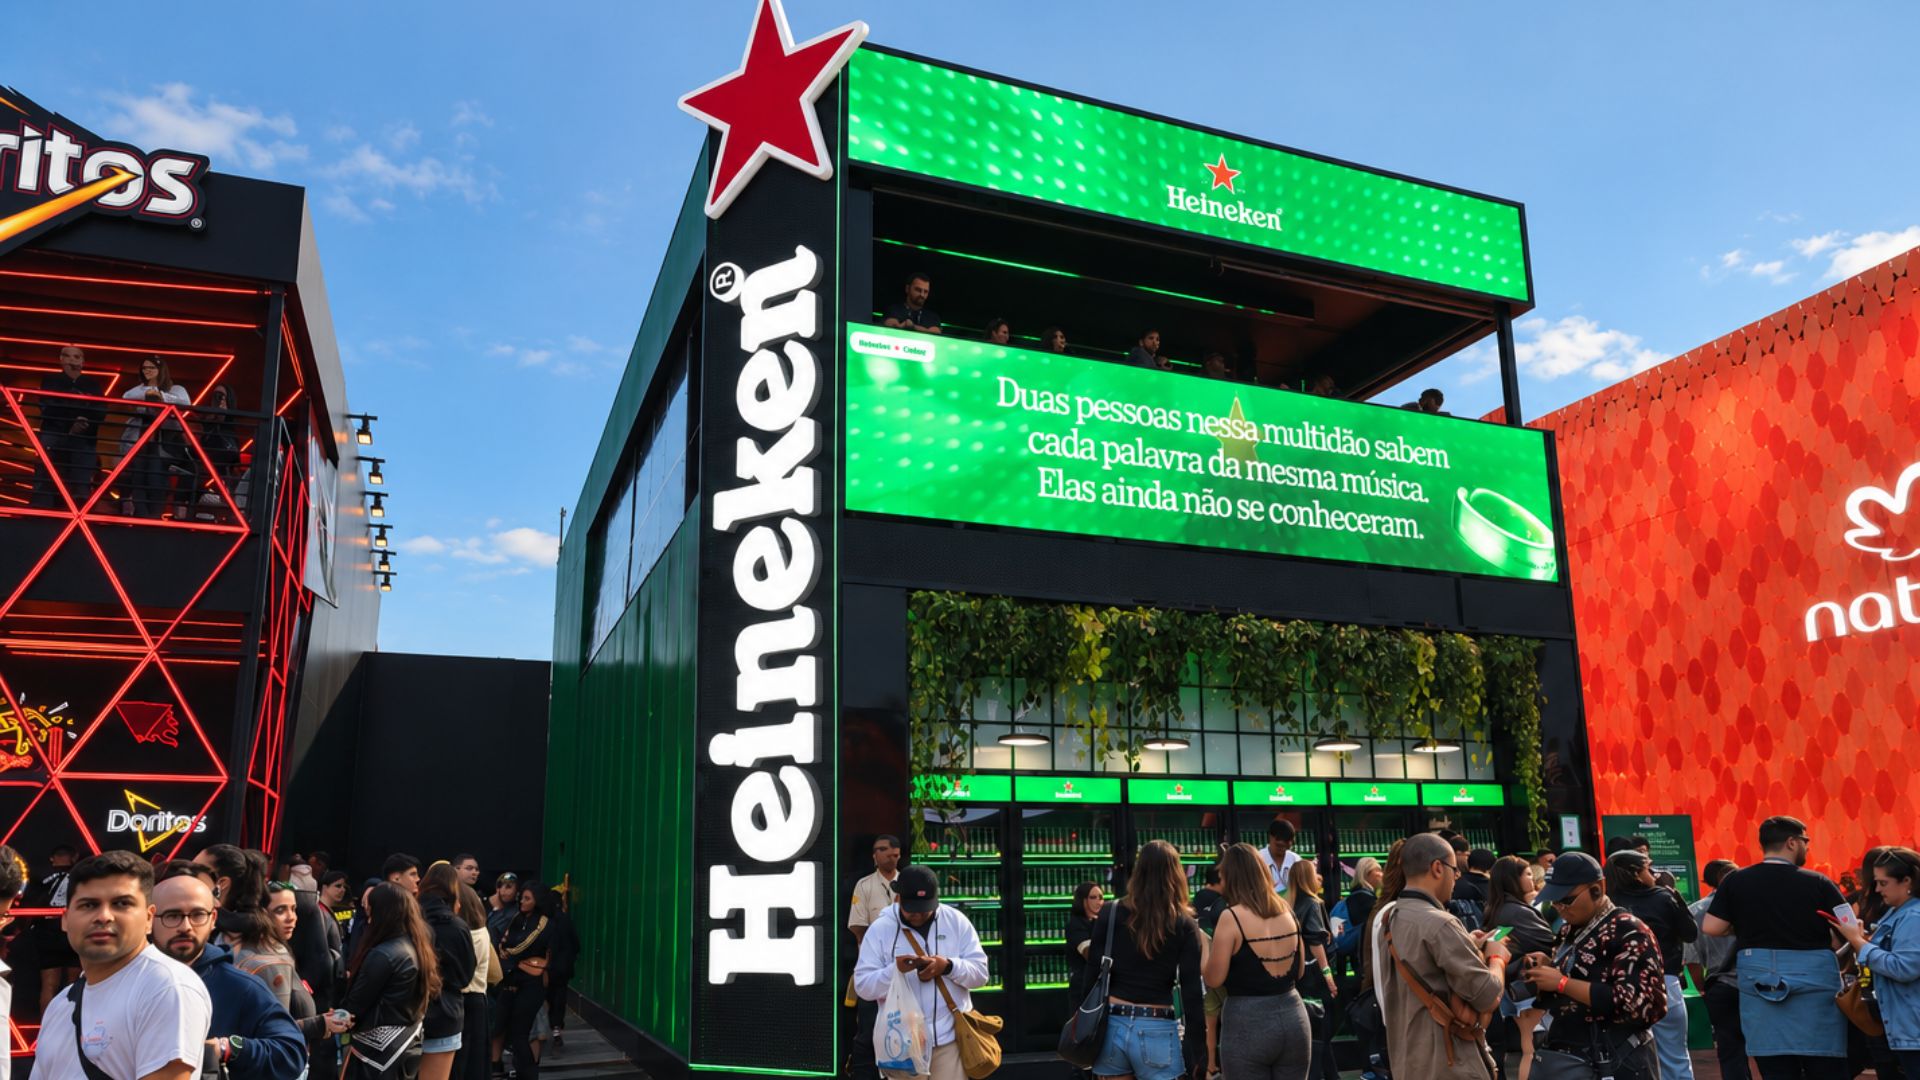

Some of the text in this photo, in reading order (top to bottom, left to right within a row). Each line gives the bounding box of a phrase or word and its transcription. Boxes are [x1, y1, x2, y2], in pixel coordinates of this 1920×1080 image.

[996, 375, 1451, 469] Duas pessoas nessa multidão sabem
[1027, 428, 1430, 503] cada palavra da mesma música.
[1037, 466, 1425, 540] Elas ainda não se conheceram.
[1804, 576, 1920, 642] nat
[106, 809, 207, 834] Doritos
